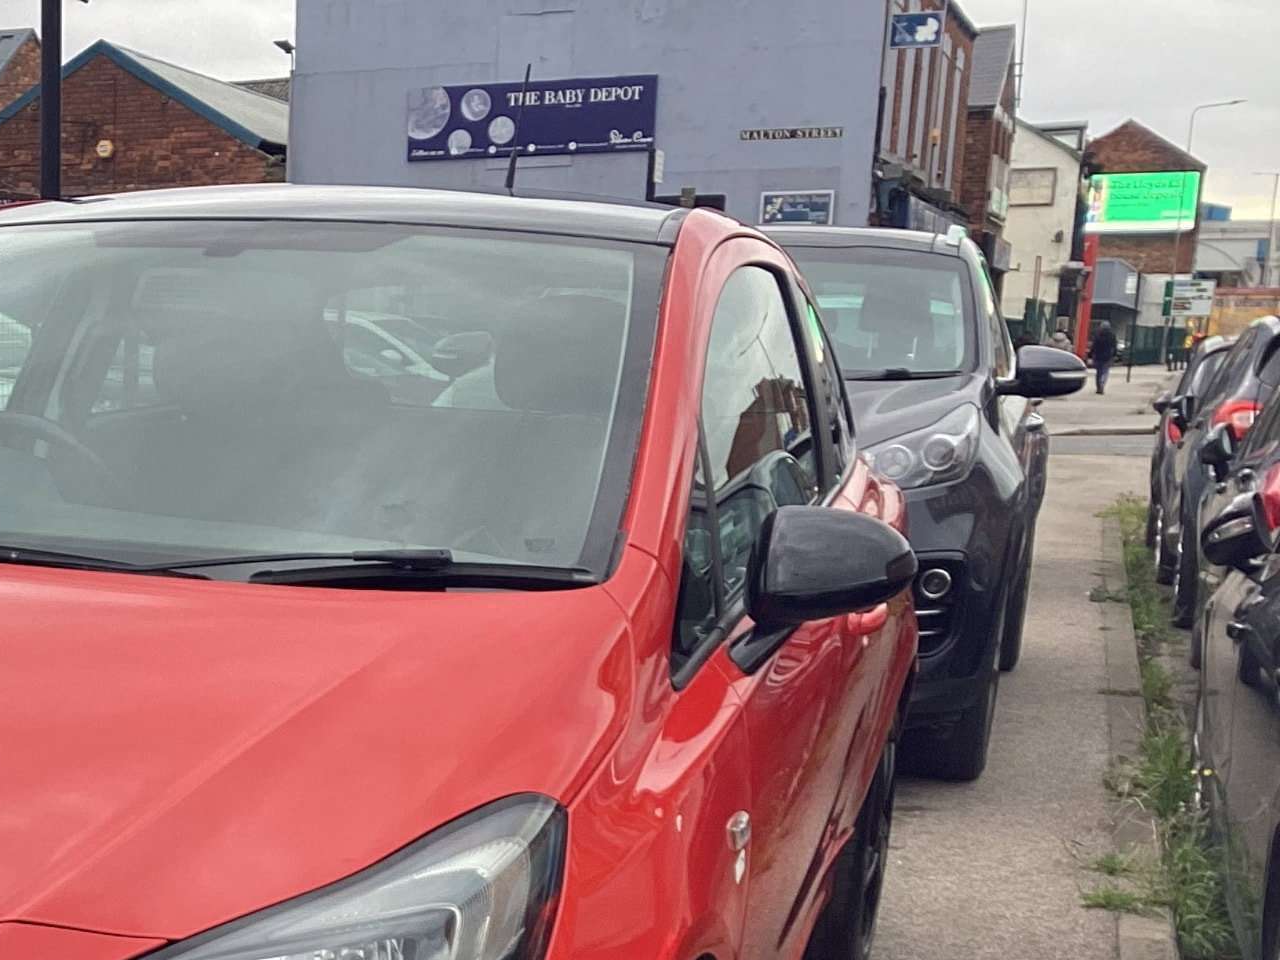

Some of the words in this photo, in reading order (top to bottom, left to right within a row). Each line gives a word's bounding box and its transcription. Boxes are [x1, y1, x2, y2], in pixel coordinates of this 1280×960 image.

[506, 90, 540, 107] THE
[544, 88, 586, 105] BABY
[589, 85, 644, 102] DEPOT
[741, 129, 791, 140] MALTON
[796, 127, 842, 138] STREET
